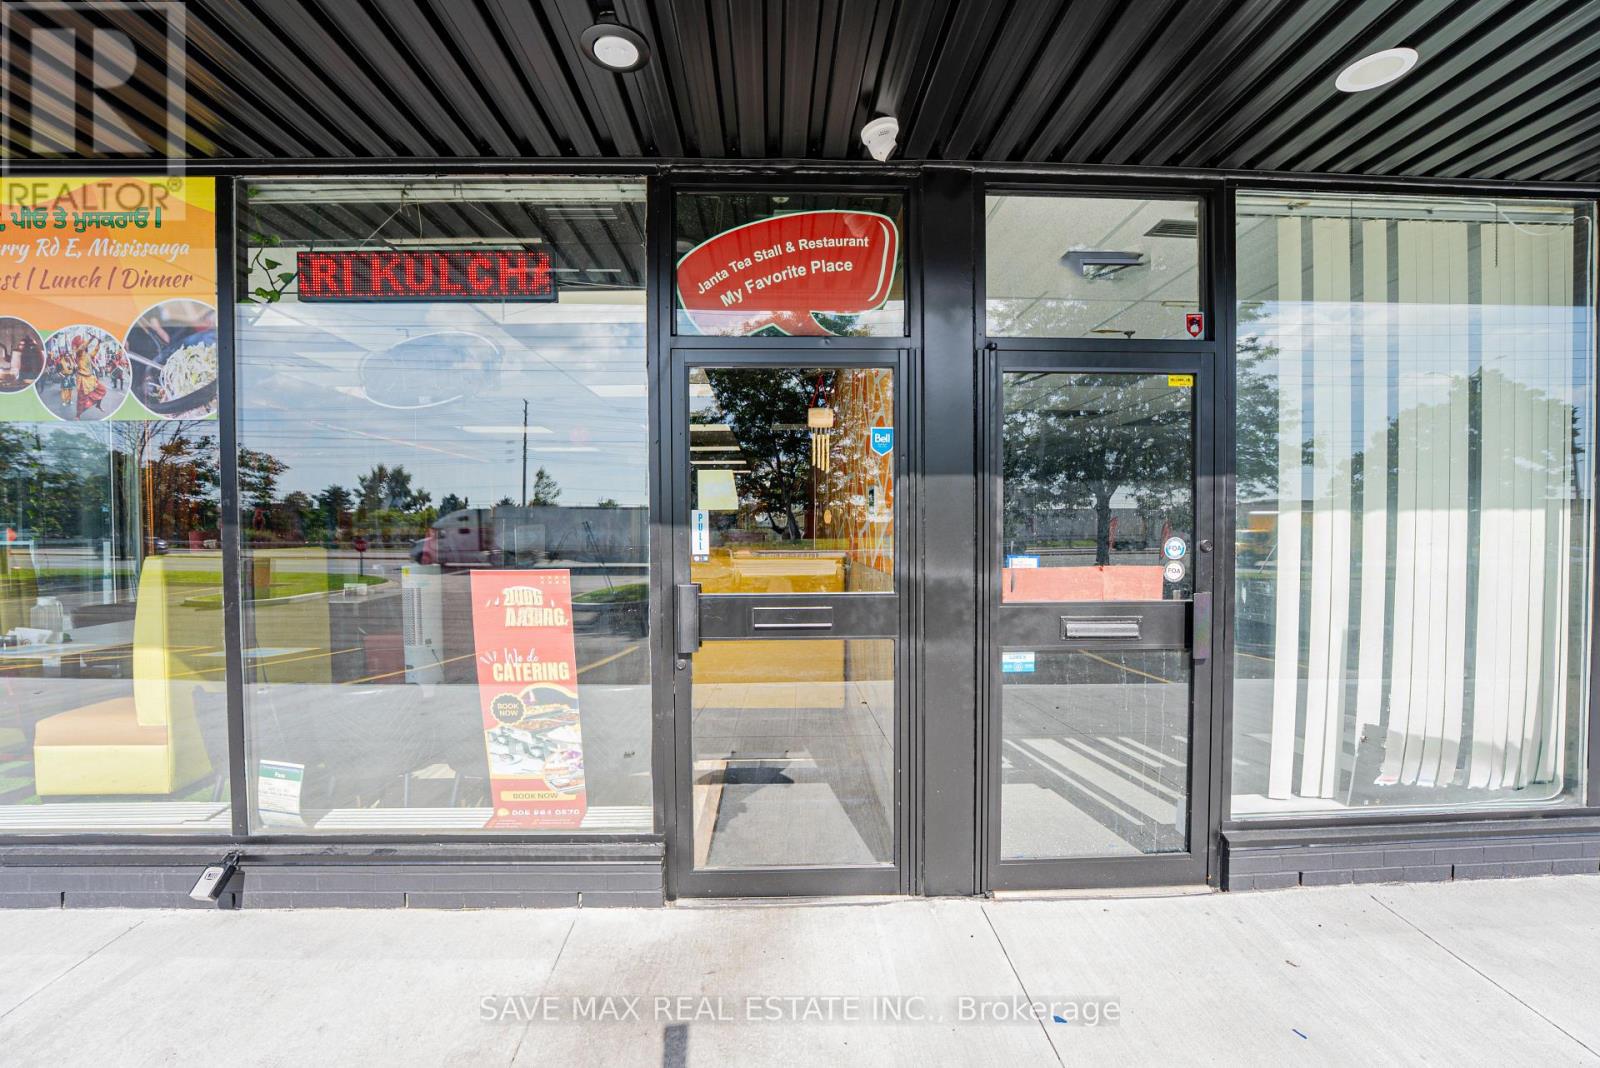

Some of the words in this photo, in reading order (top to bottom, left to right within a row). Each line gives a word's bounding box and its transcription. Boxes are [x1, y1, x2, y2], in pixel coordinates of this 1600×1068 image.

[0, 244, 31, 264] rry
[36, 236, 60, 257] Rd
[87, 238, 190, 263] Mississauga
[0, 271, 21, 291] st
[40, 266, 103, 290] Lunch
[122, 267, 193, 290] Dinner
[698, 269, 730, 295] Janta
[729, 257, 753, 273] Tea
[753, 244, 783, 262] Stall
[785, 241, 796, 254] &
[798, 236, 869, 251] Restaurant
[720, 288, 744, 307] My
[744, 264, 807, 294] Favorite
[811, 259, 854, 274] Place
[875, 433, 890, 442] Bell
[492, 662, 570, 682] CATERING
